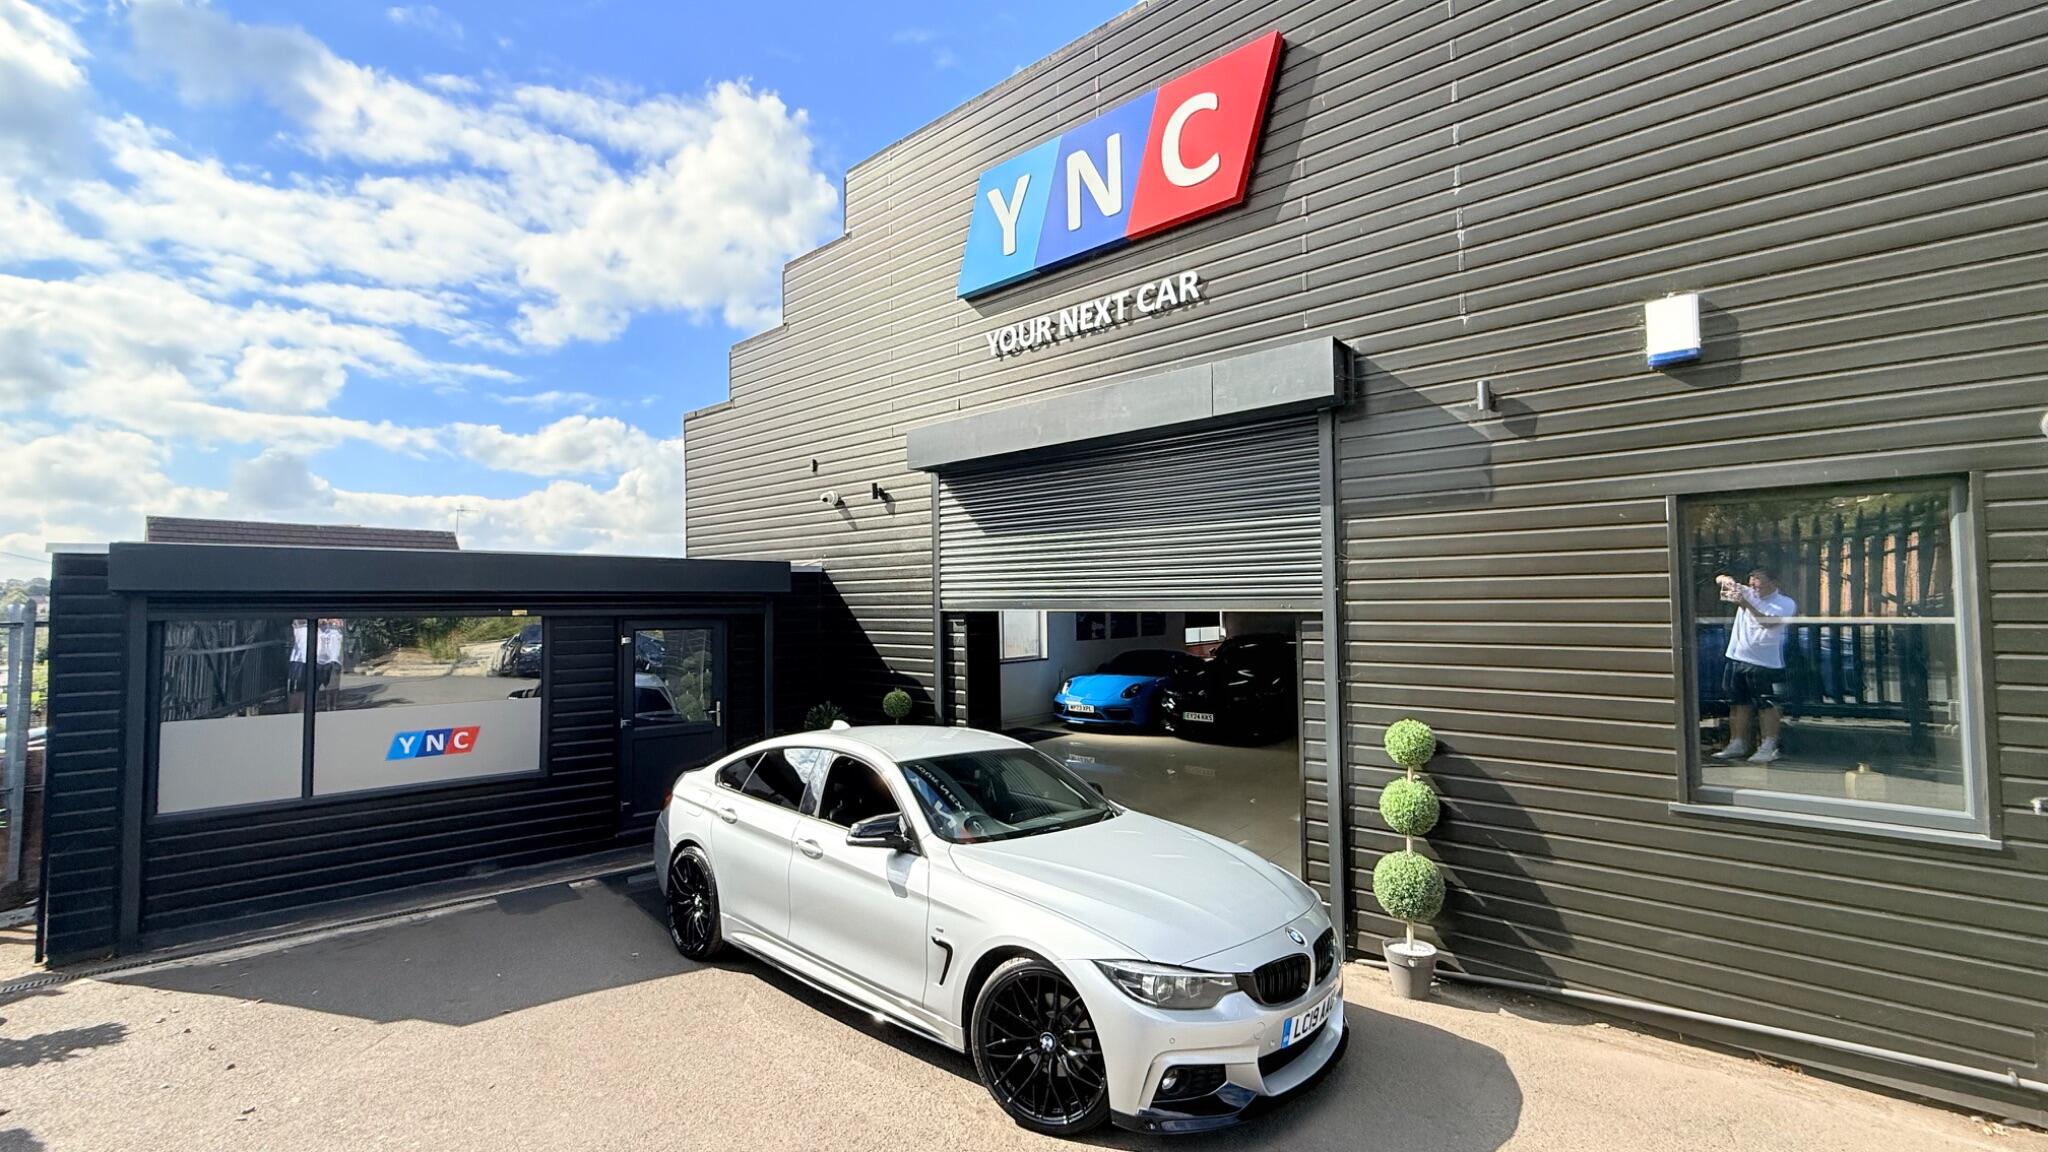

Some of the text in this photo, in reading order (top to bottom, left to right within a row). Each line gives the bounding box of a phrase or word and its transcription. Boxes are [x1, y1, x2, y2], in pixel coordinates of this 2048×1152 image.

[987, 92, 1220, 256] YNC
[985, 270, 1200, 356] YOUR NEXT CAR
[399, 731, 469, 754] YNC
[1293, 1006, 1320, 1038] LC19
